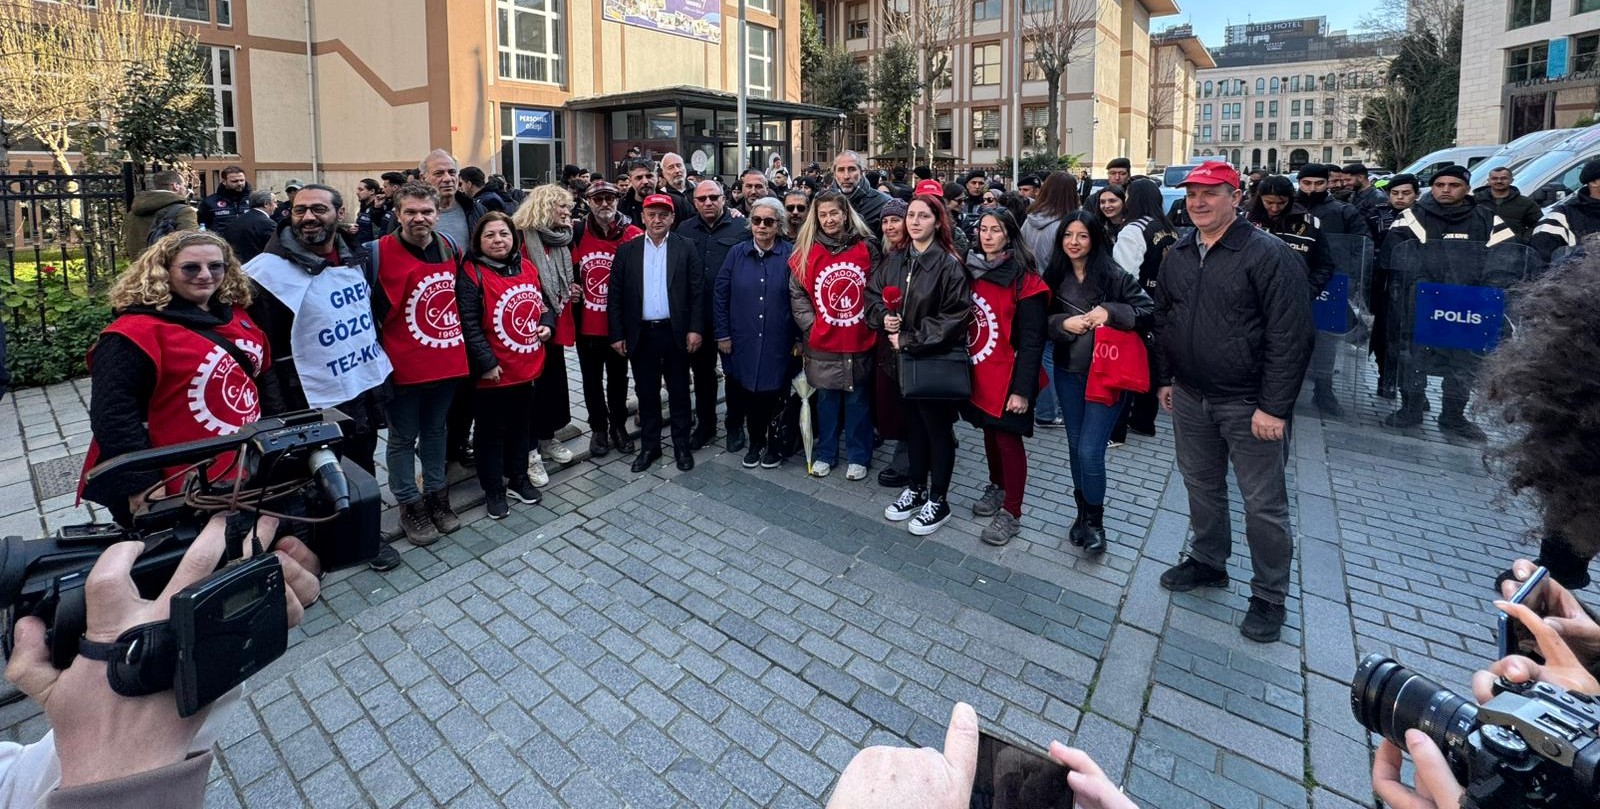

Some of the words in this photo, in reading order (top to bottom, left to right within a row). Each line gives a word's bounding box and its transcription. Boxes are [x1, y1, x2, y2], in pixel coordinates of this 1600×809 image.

[1246, 24, 1273, 33] RITUS
[1273, 21, 1303, 30] HOTEL
[1286, 243, 1310, 252] OLİS
[836, 311, 854, 319] 1962
[1433, 309, 1483, 325] POLİS
[318, 311, 372, 347] GÖZC
[438, 327, 461, 339] 1962
